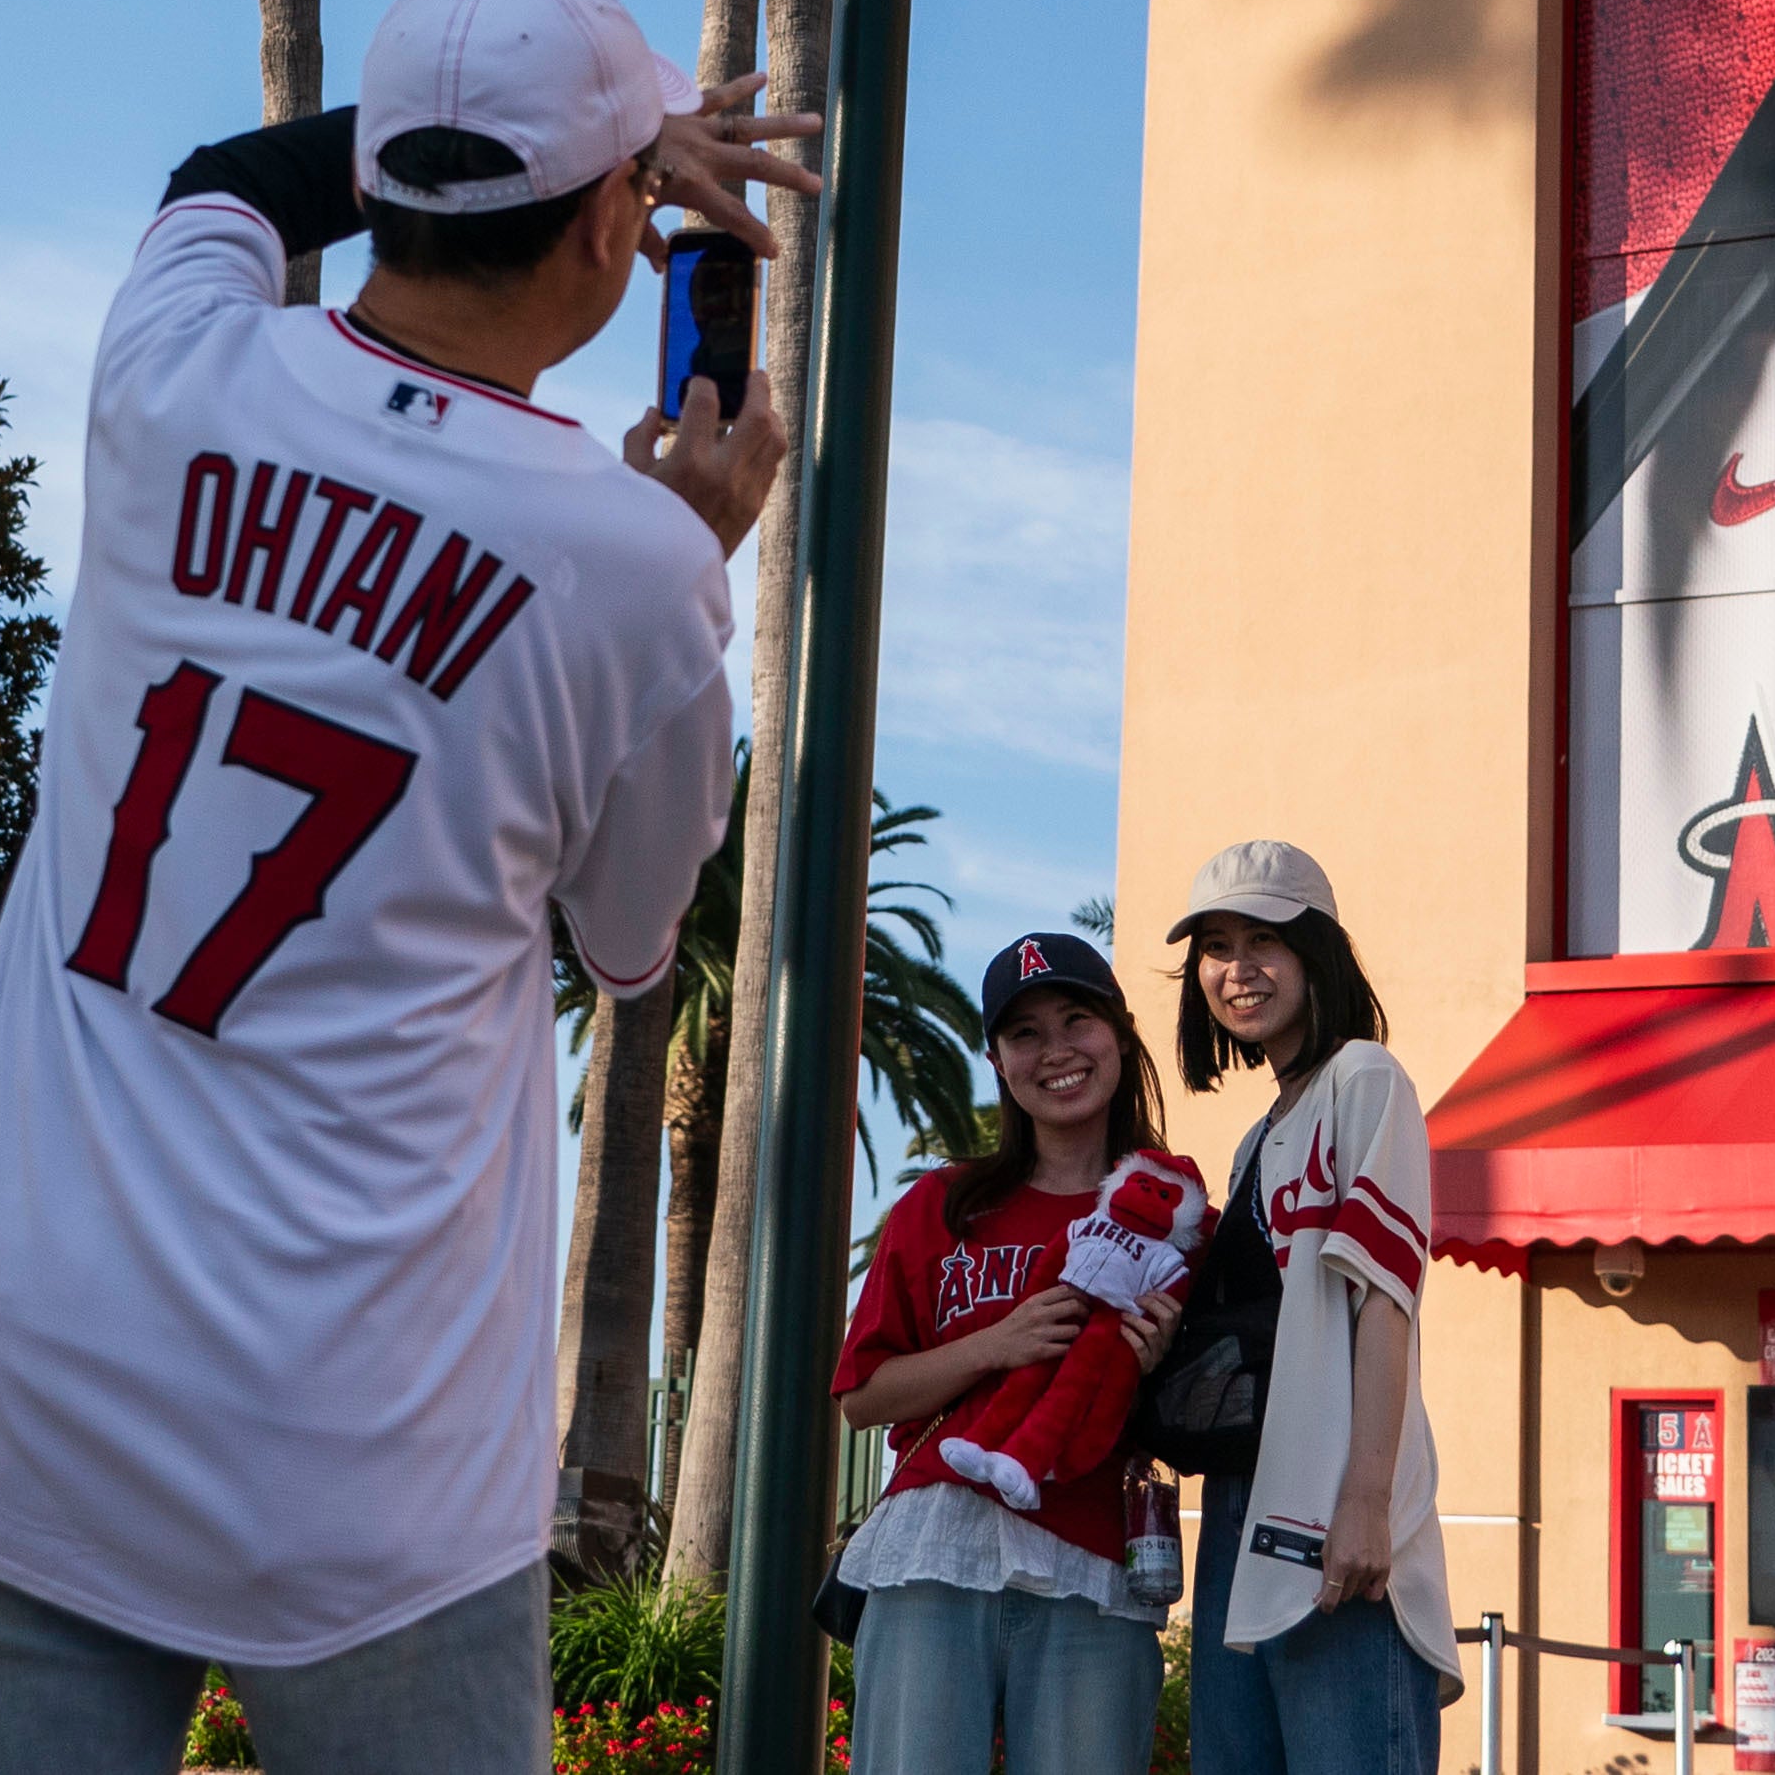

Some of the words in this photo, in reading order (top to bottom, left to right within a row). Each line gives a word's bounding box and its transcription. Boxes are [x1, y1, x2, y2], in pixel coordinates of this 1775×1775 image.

[172, 451, 536, 702] OHTANI
[66, 659, 417, 1039] 17
[1018, 938, 1052, 981] A
[1076, 1217, 1147, 1262] ANGELS
[1645, 1412, 1680, 1447] 15
[1644, 1453, 1715, 1476] TICKET
[1654, 1475, 1707, 1497] SALES
